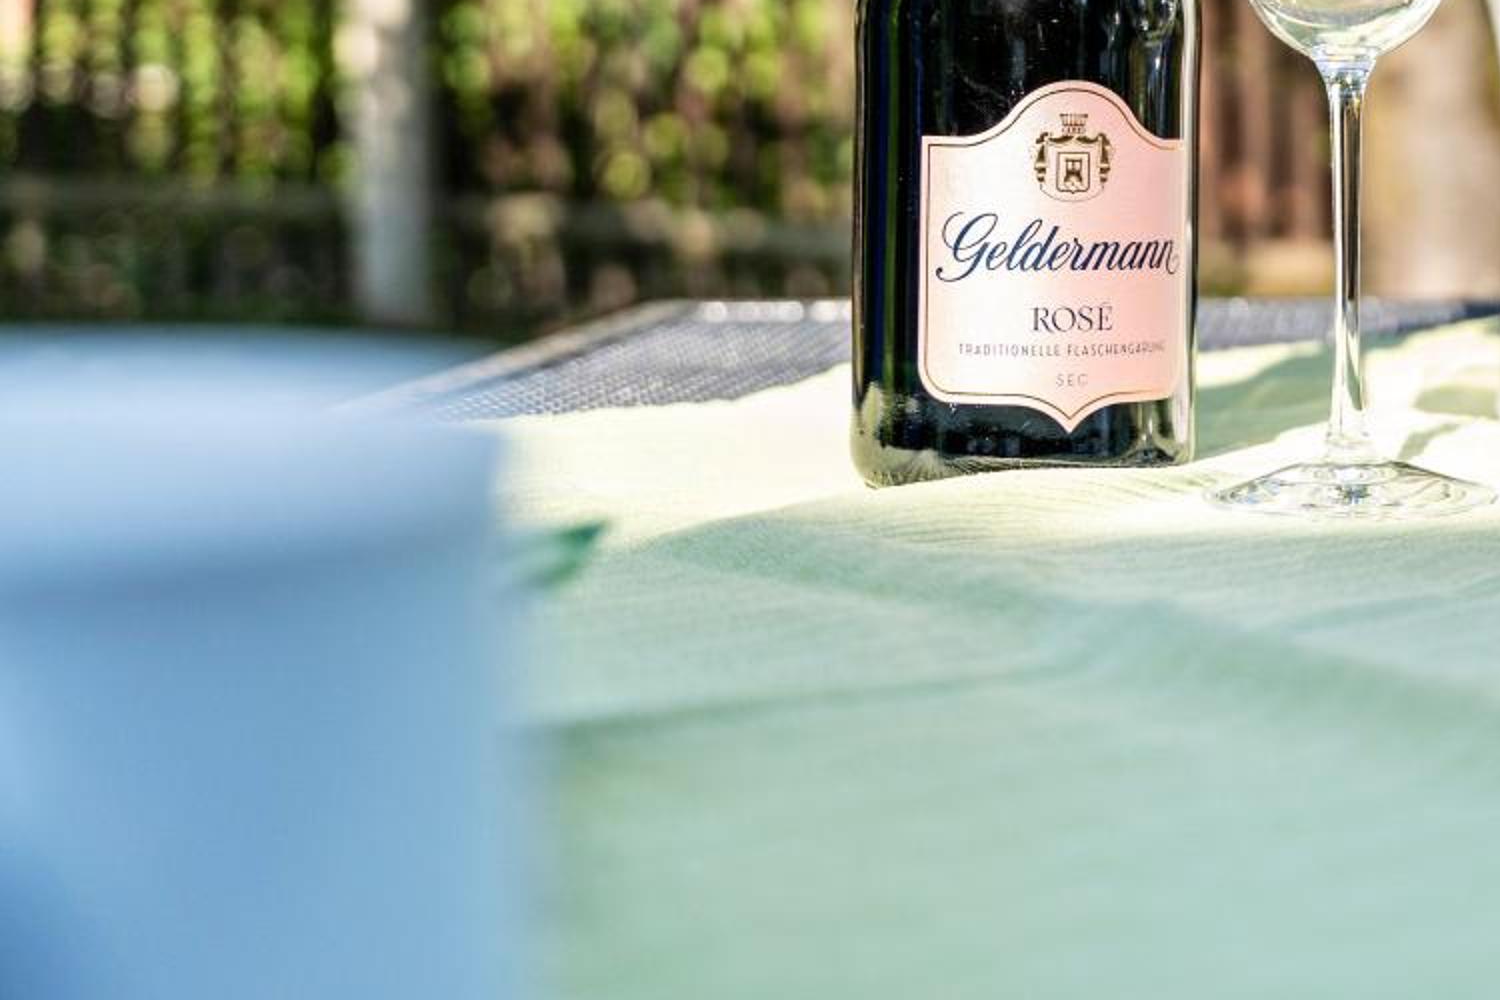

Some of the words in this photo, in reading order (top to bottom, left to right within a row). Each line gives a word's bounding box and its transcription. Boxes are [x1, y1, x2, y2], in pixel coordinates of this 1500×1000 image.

[936, 211, 1179, 283] Geldermann
[959, 343, 1060, 358] TRADITIONELLE
[1056, 374, 1088, 388] SEC
